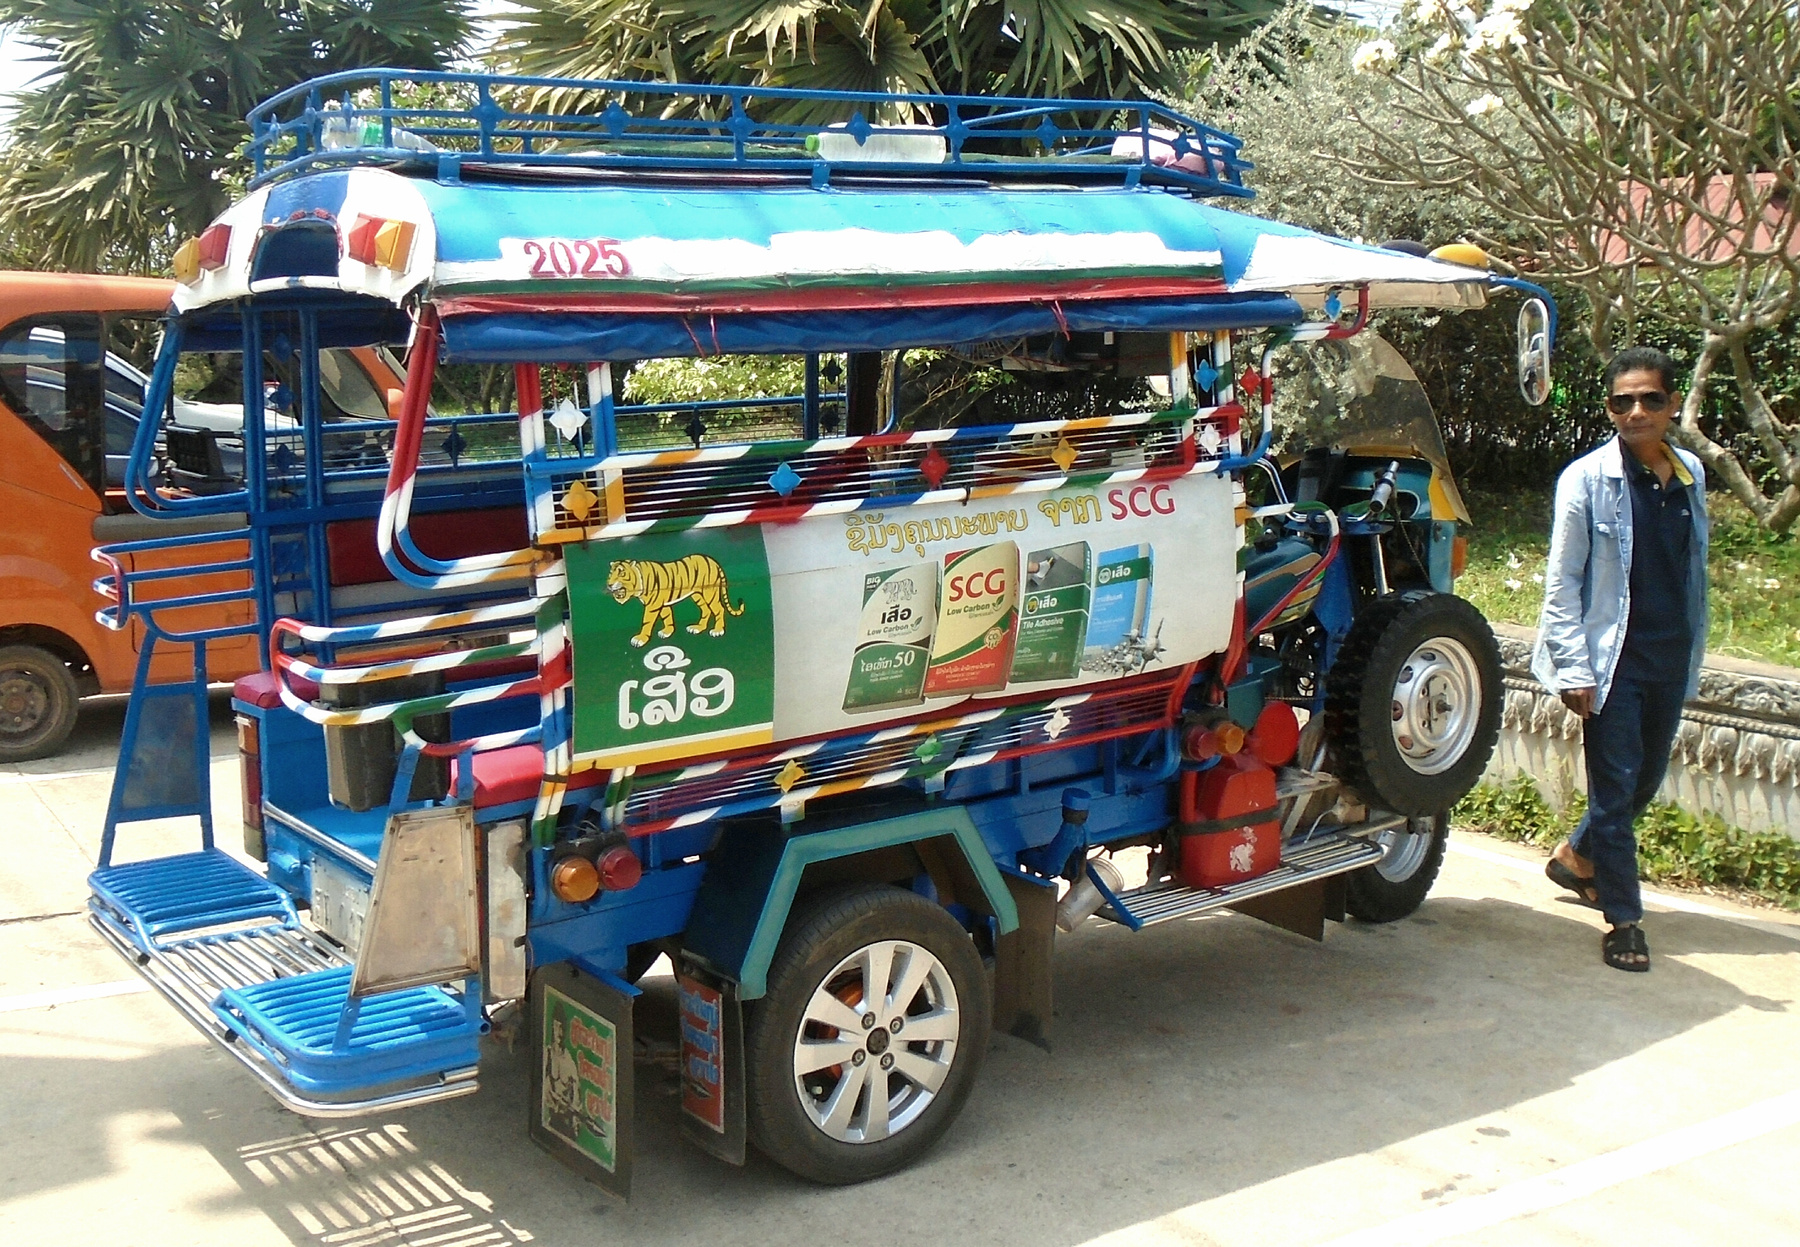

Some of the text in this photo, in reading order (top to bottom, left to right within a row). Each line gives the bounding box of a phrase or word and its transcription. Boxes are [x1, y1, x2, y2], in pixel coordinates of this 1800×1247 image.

[523, 239, 631, 278] 2025
[1037, 494, 1102, 527] ຈາກ
[1107, 484, 1176, 521] SCG
[948, 567, 1006, 602] SCG
[880, 603, 912, 625] เสือ
[946, 607, 963, 616] Low
[963, 602, 991, 613] Carbon
[866, 628, 882, 636] Low
[883, 623, 909, 633] Carbon
[893, 650, 916, 668] 50
